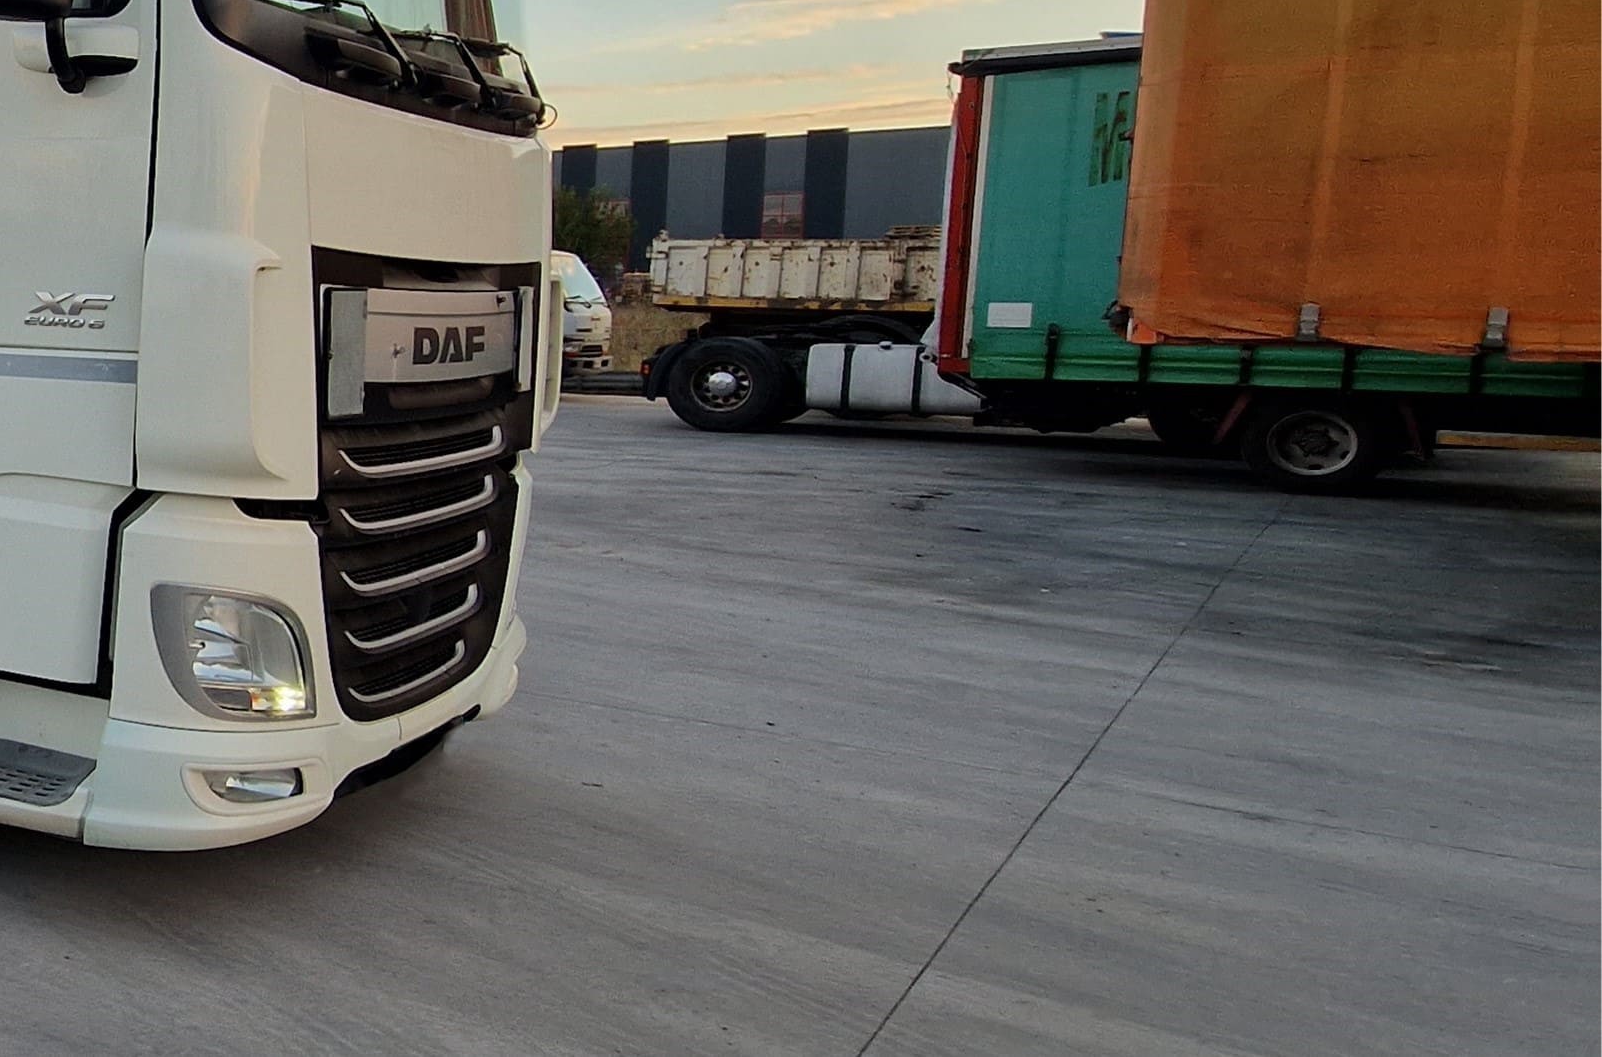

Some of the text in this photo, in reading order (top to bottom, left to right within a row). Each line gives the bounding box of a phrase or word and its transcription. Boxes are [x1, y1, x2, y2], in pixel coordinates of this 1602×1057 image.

[28, 290, 116, 316] XF
[24, 316, 105, 330] EURO 6
[411, 325, 486, 365] DAF
